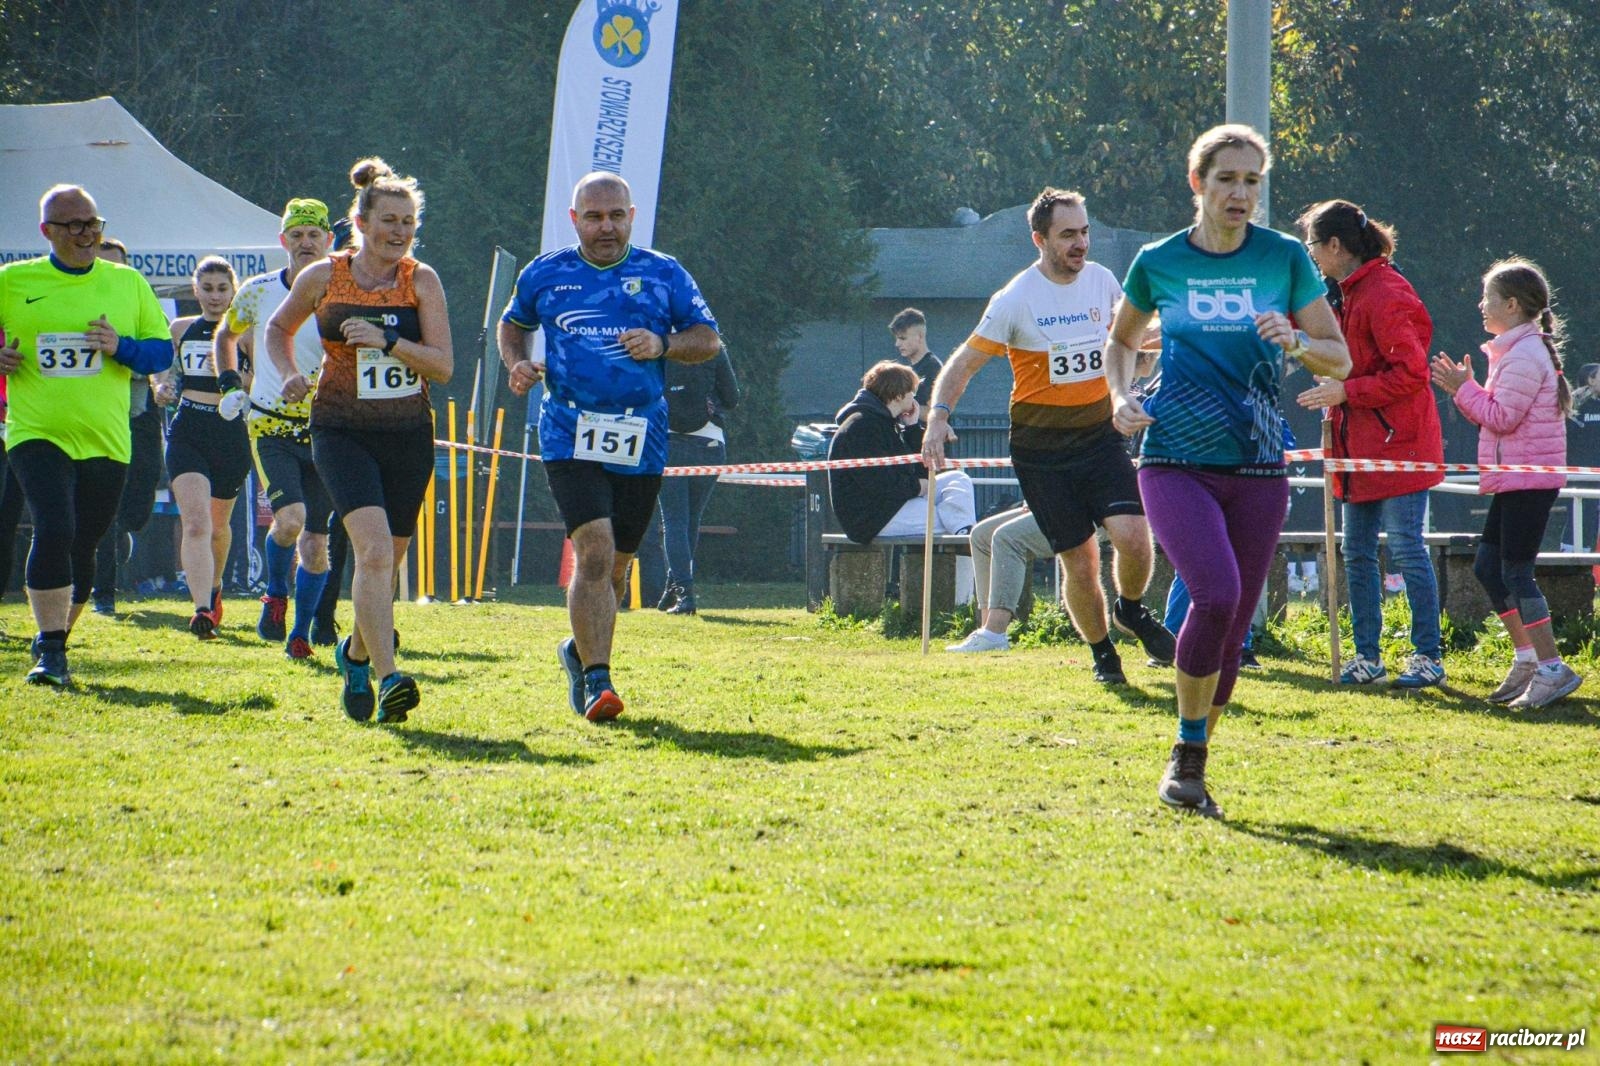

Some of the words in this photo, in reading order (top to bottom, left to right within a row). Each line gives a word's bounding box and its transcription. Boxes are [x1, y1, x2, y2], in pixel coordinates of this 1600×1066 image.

[218, 254, 267, 276] UTRA
[1188, 289, 1257, 320] bbl
[381, 313, 398, 326] 10
[1037, 317, 1057, 327] SAP
[1058, 313, 1089, 325] Hybris
[40, 348, 98, 369] 337
[184, 352, 209, 370] 17
[1053, 349, 1103, 376] 338
[362, 366, 419, 389] 169
[192, 403, 215, 413] NIKE
[581, 428, 638, 457] 151
